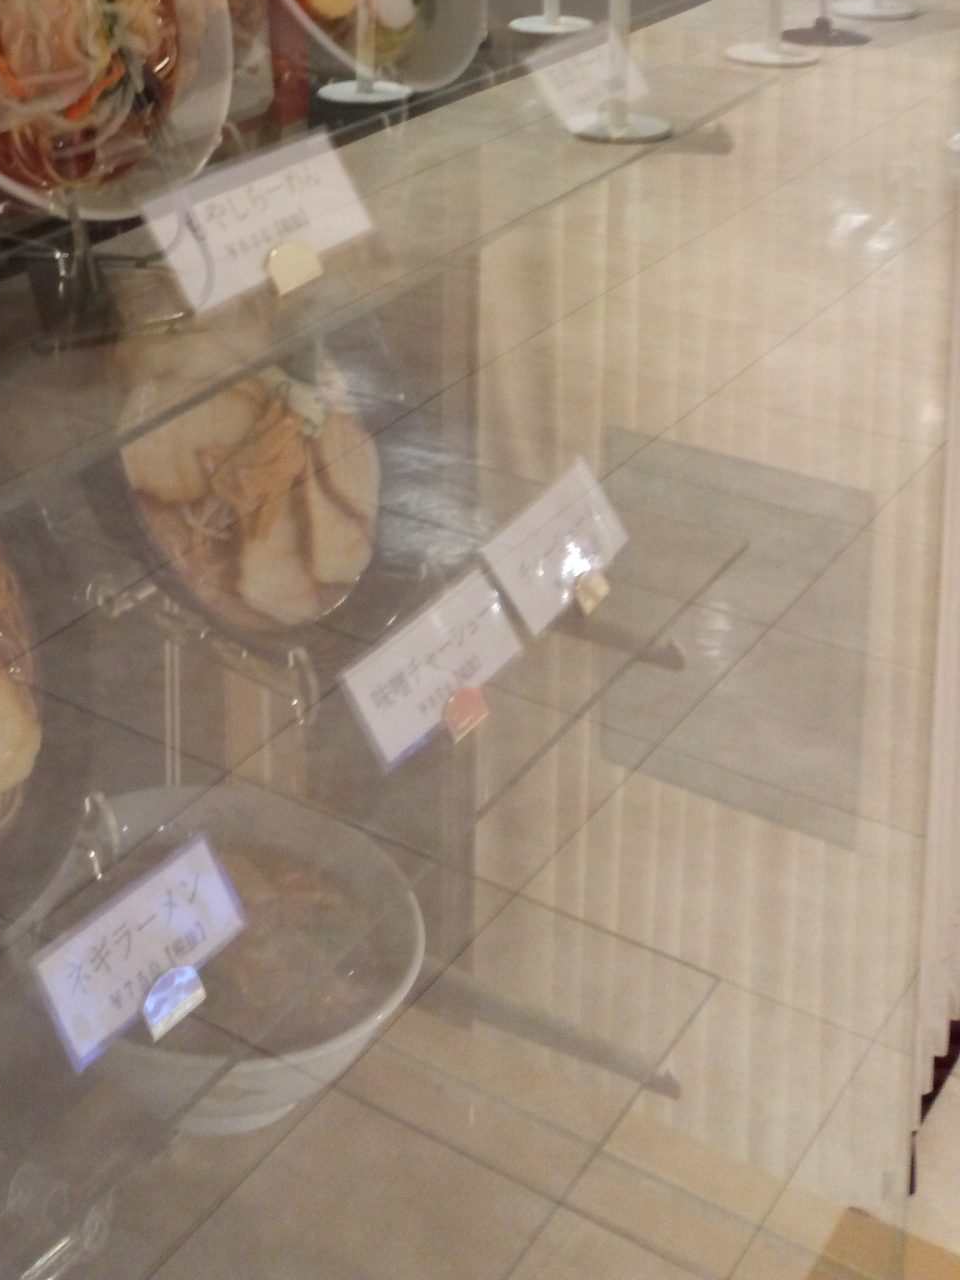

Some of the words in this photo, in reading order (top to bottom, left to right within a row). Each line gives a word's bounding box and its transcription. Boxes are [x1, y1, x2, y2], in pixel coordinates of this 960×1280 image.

[66, 873, 200, 995] ネギラーメン
